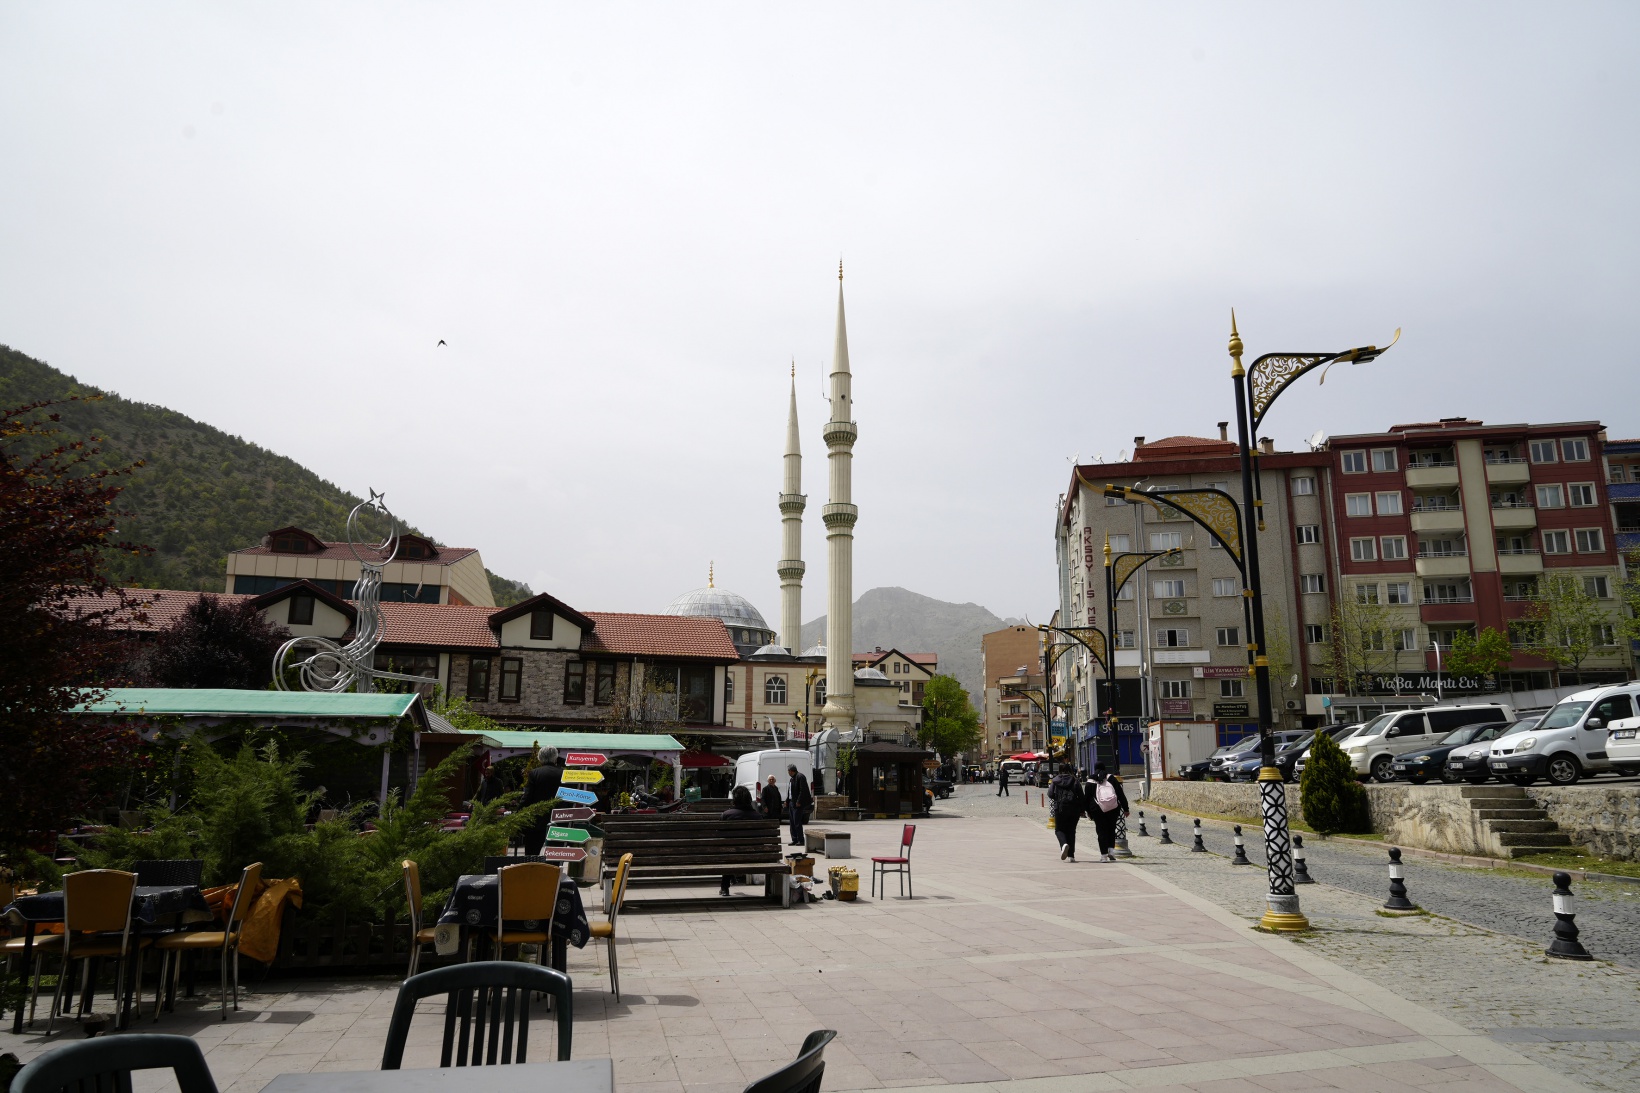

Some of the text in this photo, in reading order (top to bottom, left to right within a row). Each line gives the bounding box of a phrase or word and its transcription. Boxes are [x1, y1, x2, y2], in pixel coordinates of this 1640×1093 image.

[1084, 526, 1094, 572] AKSOY
[1087, 606, 1098, 674] MEZİ
[1458, 676, 1479, 689] Evi
[1102, 723, 1134, 734] gtaş
